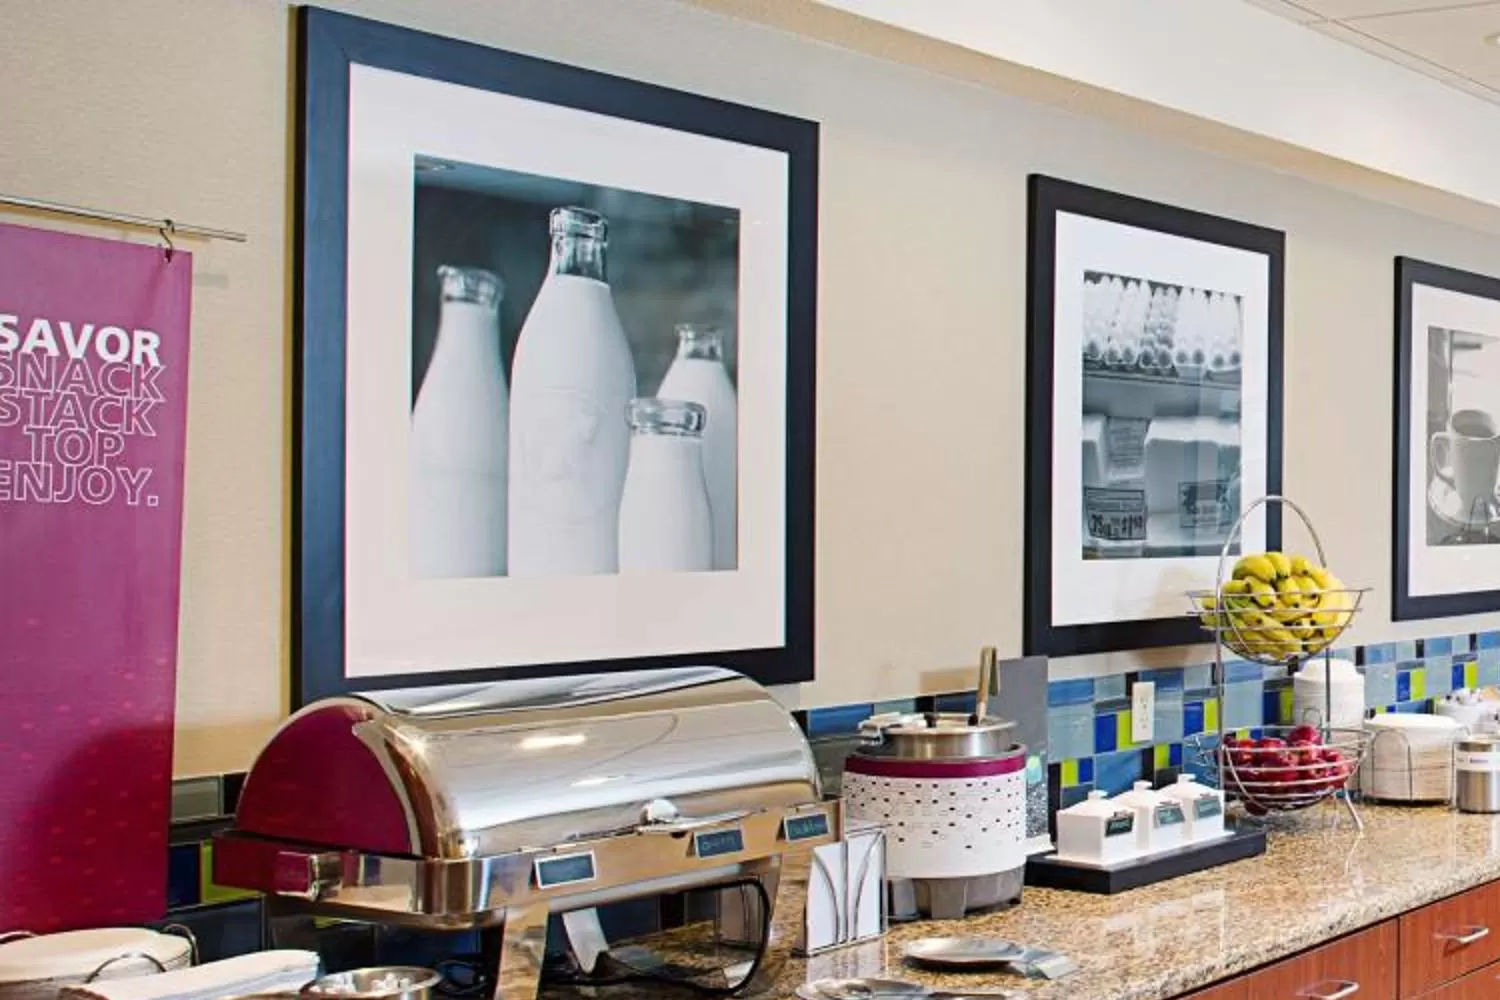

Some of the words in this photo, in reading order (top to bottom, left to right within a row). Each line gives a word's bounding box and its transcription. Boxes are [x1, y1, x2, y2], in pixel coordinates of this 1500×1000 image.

[0, 314, 161, 366] SAVOR
[0, 387, 157, 436] STACK
[23, 425, 125, 467] TOP
